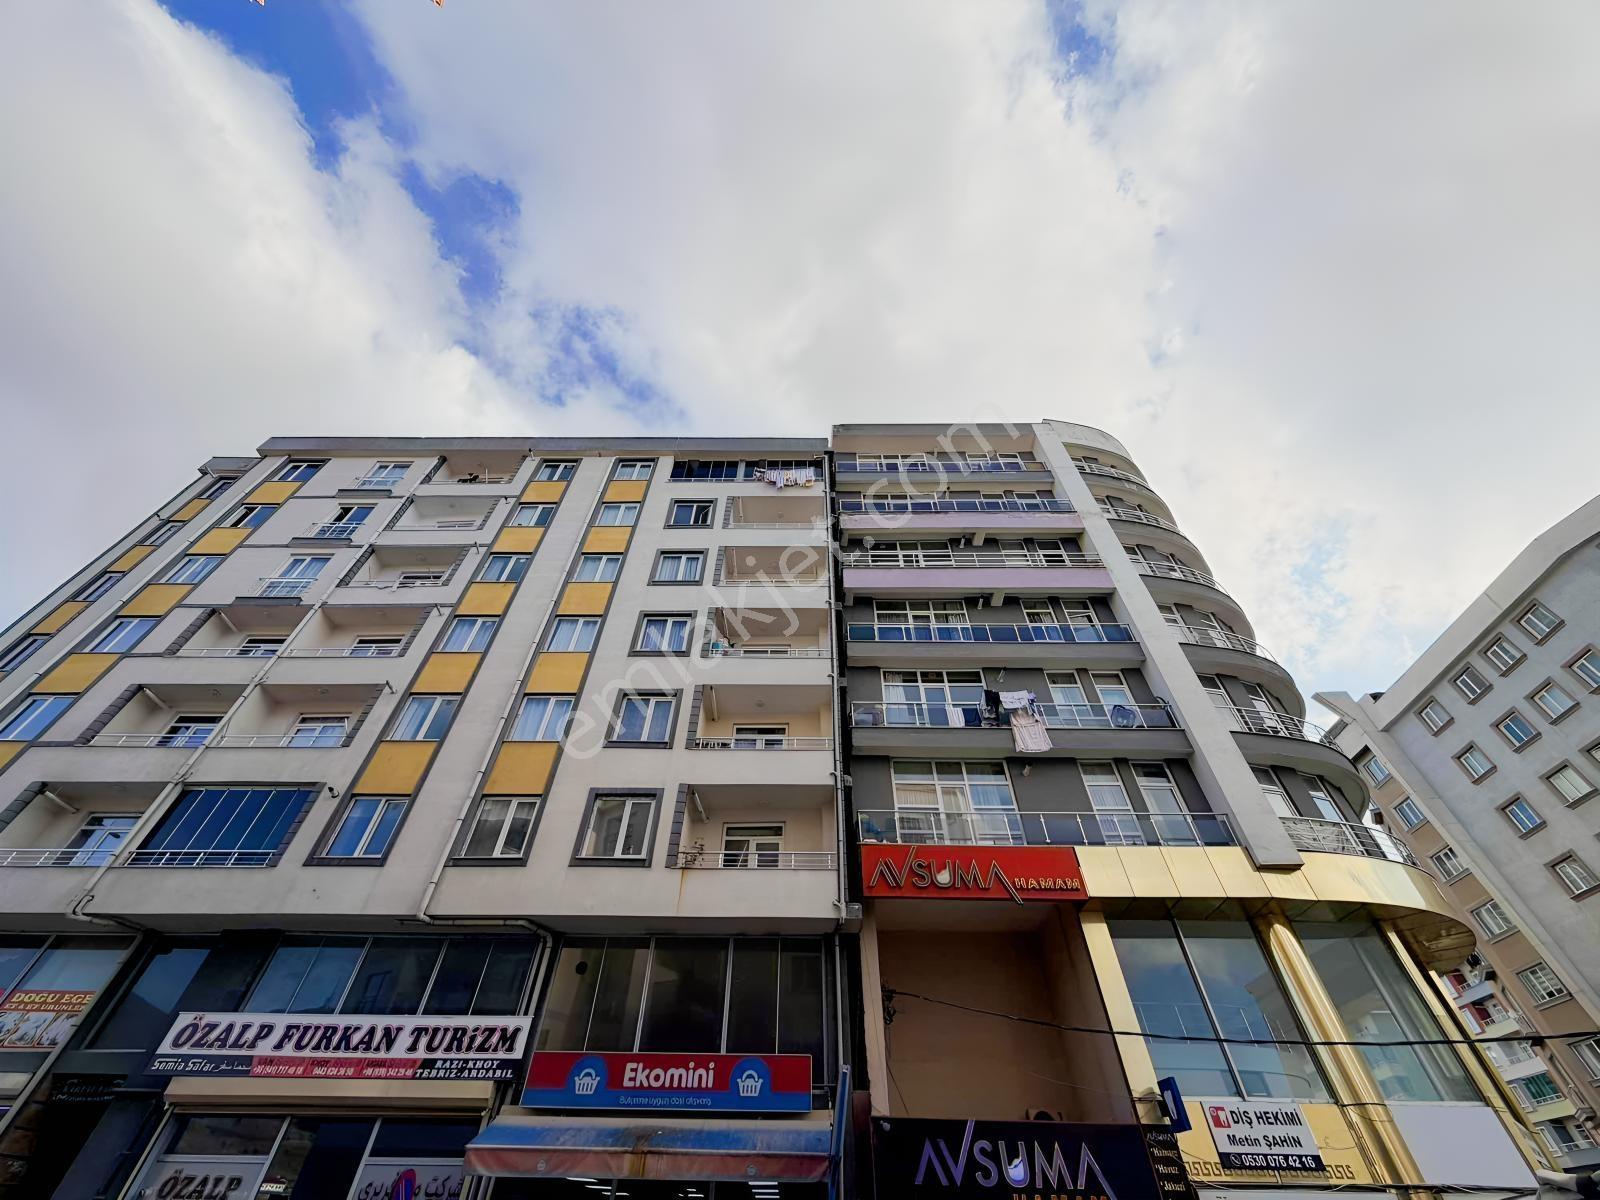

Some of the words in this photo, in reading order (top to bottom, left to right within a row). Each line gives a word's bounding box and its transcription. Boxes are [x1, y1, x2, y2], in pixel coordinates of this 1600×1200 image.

[1015, 878, 1081, 890] HAMAM
[170, 1014, 276, 1051] ÖZALP
[272, 1023, 405, 1054] FURKAN
[623, 1062, 714, 1088] Ekomini
[1230, 1107, 1253, 1128] DİŞ
[1254, 1108, 1302, 1126] HEKİMİ
[1227, 1133, 1262, 1147] Metin
[1263, 1133, 1303, 1150] ŞAHİN
[1242, 1154, 1268, 1167] 0530
[1268, 1155, 1287, 1167] 076
[1288, 1156, 1302, 1168] 42
[1302, 1156, 1316, 1168] 16
[158, 1168, 243, 1200] ÖZALP
